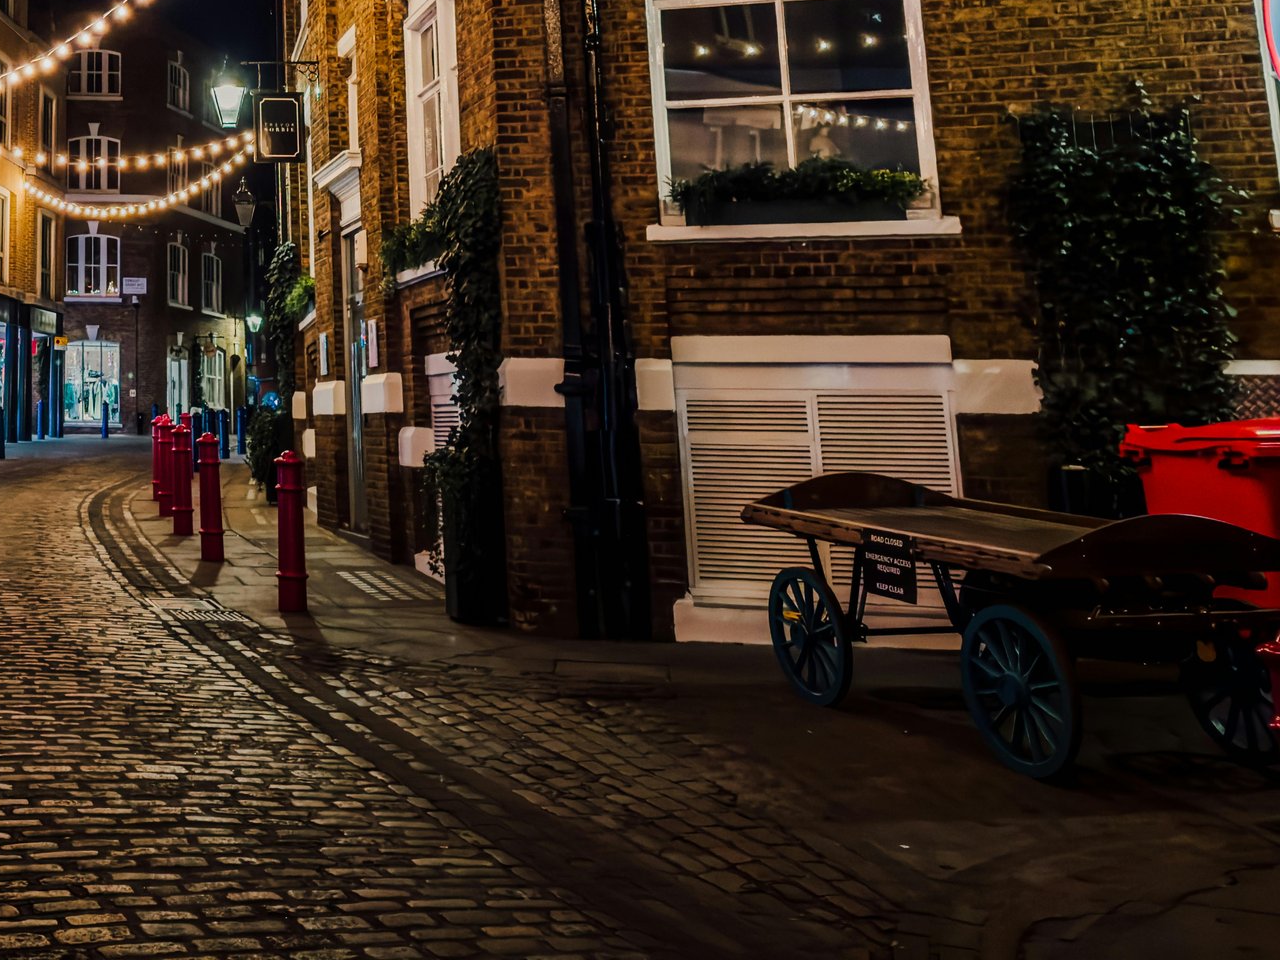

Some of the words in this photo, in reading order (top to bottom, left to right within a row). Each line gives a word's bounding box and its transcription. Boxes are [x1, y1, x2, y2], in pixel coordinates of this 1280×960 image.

[871, 534, 885, 543] ROAD
[884, 537, 903, 547] CLOSED
[865, 551, 893, 564] EMERGENCY
[893, 558, 912, 568] ACCESS
[876, 563, 901, 575] REQUIRED
[876, 582, 888, 590] KEEP
[888, 585, 904, 595] CLEAR
